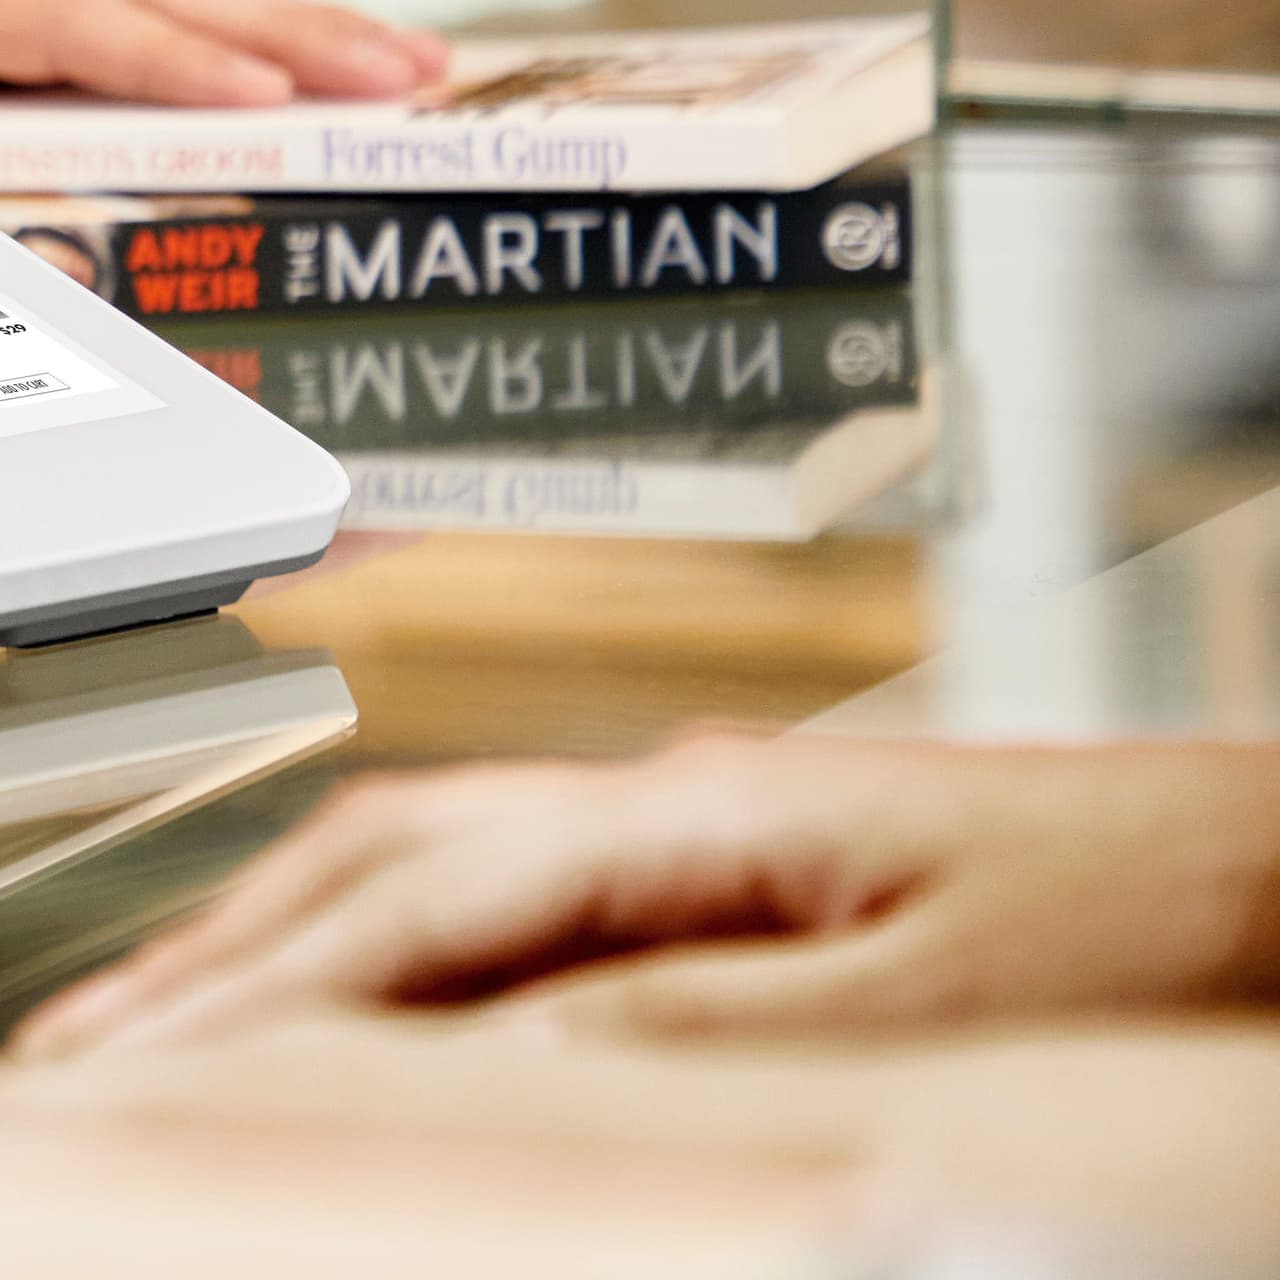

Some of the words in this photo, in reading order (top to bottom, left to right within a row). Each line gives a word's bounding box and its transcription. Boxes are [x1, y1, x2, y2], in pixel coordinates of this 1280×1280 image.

[319, 127, 477, 173] Forrest
[489, 127, 628, 191] Gump
[125, 224, 266, 272] ANDY
[286, 226, 320, 303] THE
[325, 201, 779, 304] MARTIAN
[132, 271, 260, 315] WEIR
[13, 383, 29, 391] TO
[26, 379, 48, 389] CART
